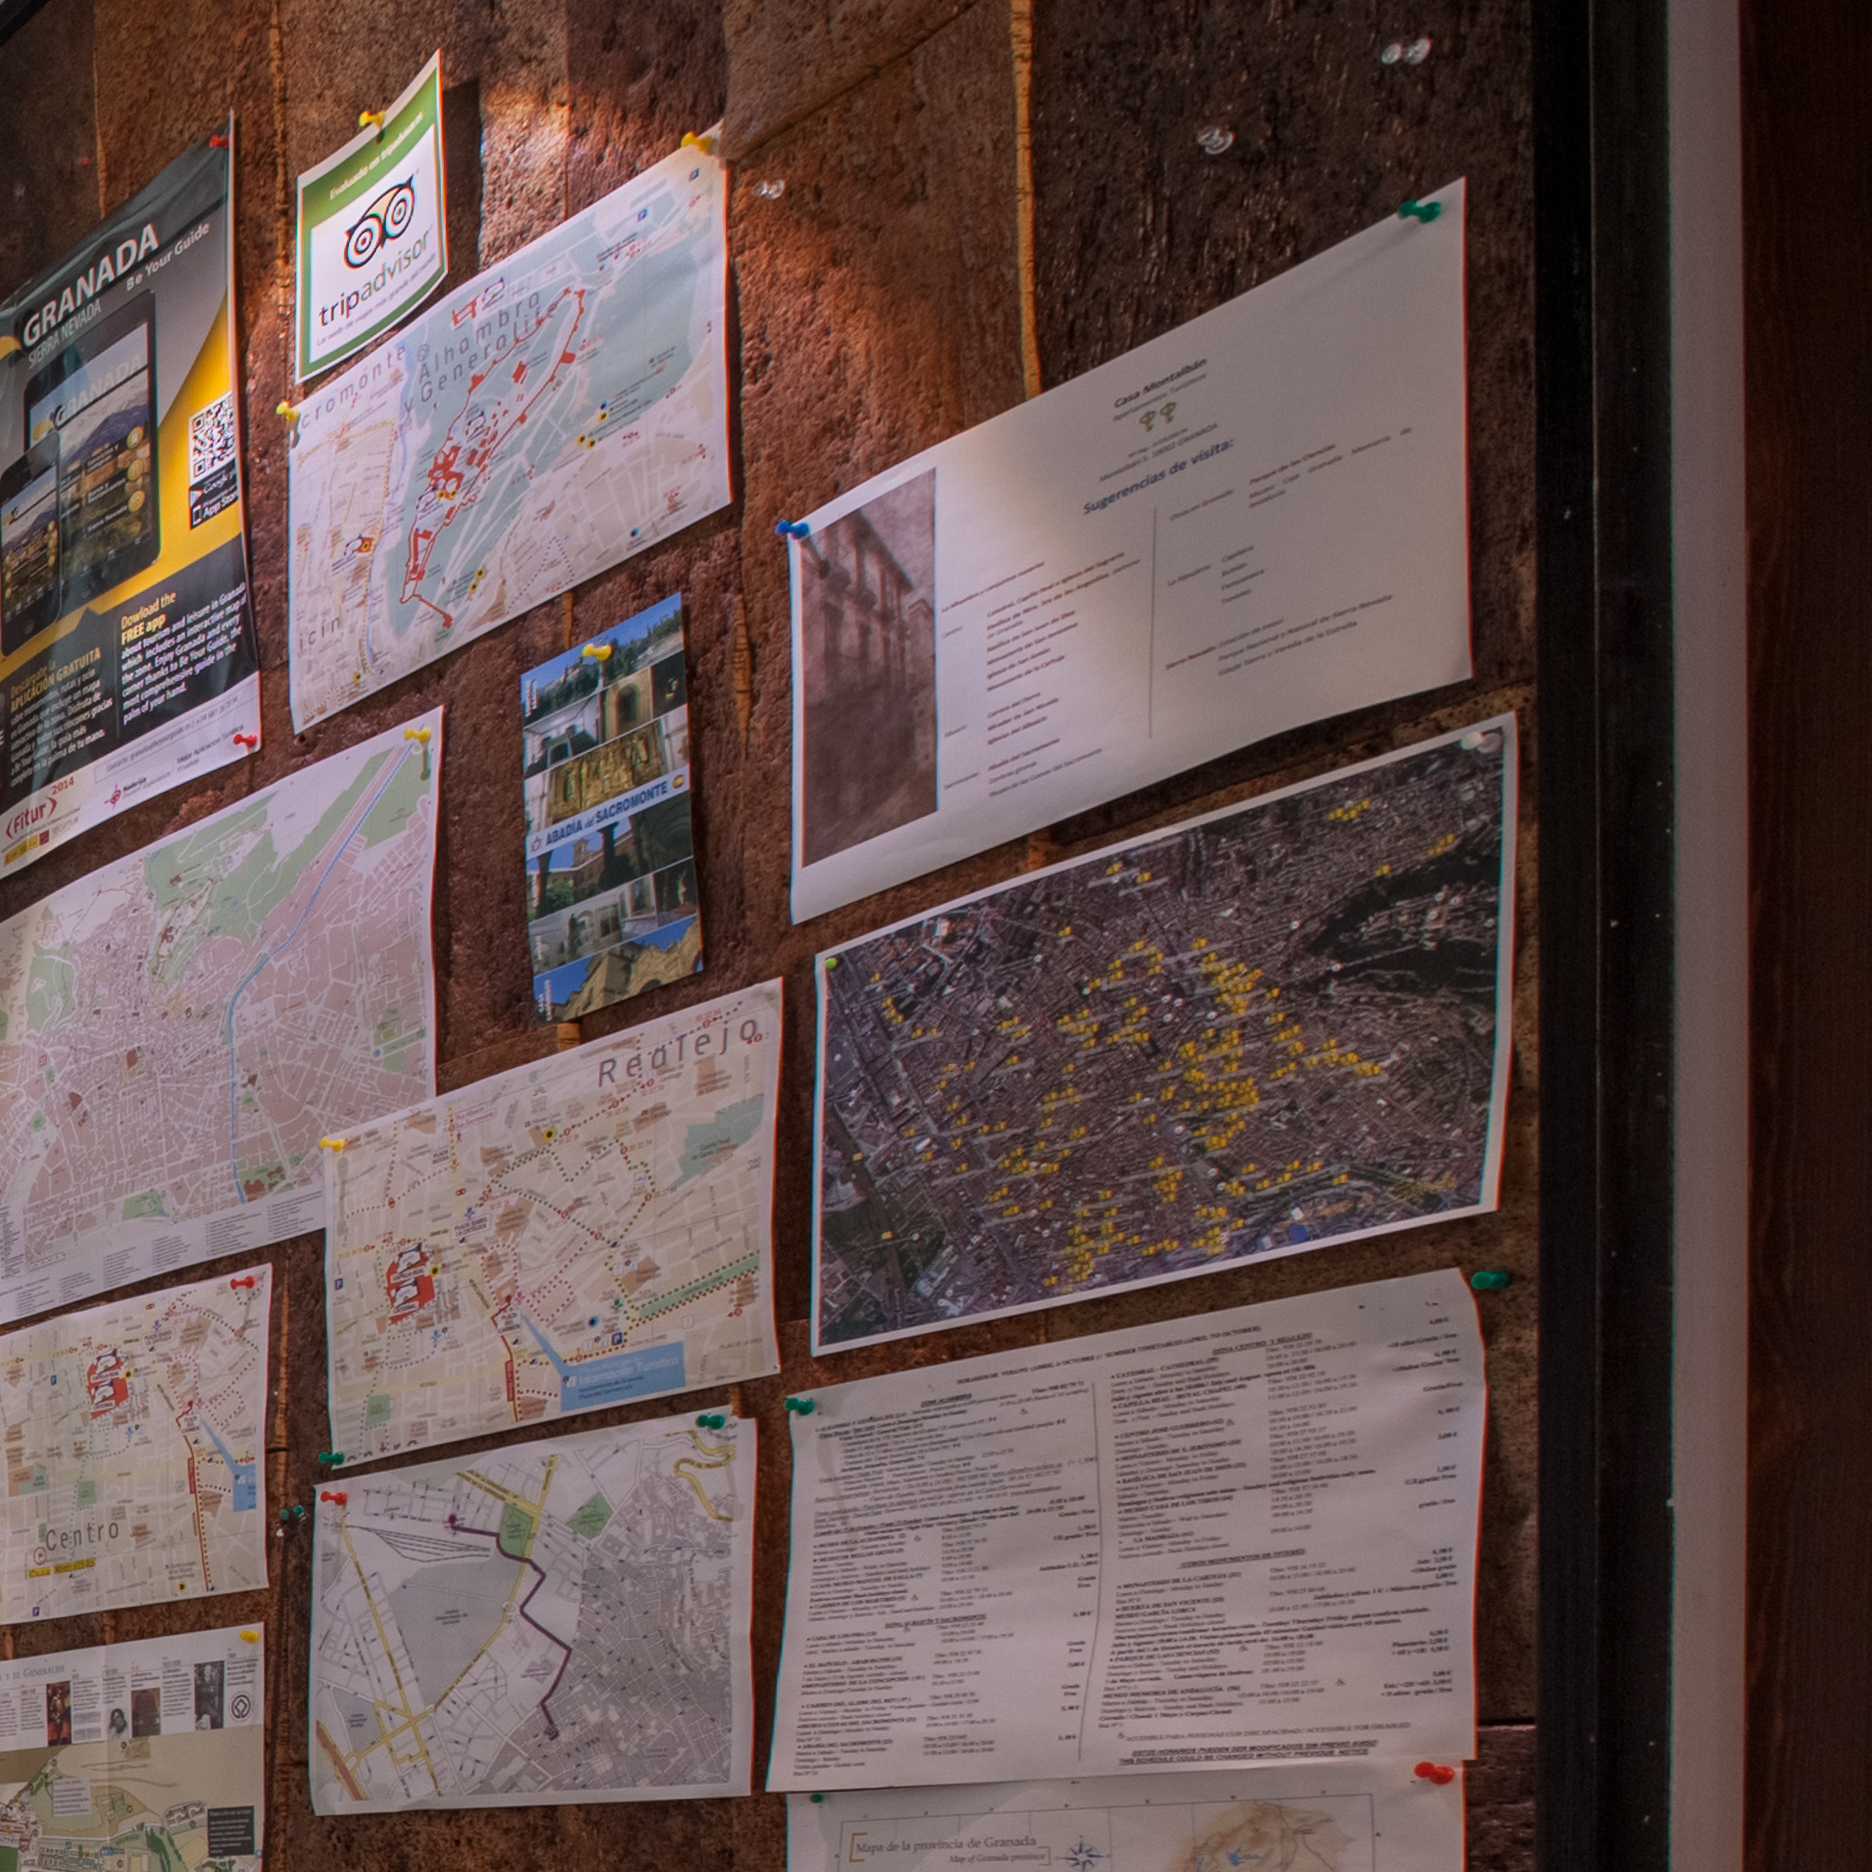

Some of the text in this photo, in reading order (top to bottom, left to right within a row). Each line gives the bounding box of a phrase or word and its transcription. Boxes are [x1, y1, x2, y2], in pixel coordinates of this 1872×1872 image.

[126, 222, 210, 292] Be Your Guide
[24, 223, 160, 348] GRANADA
[319, 230, 429, 328] tripadvisor
[28, 298, 102, 370] SIERRA NEVADA
[328, 324, 342, 342] web
[419, 291, 541, 385] Alhambra
[419, 299, 557, 404] Generalife
[1114, 358, 1208, 408] Casa Montalbán
[1083, 437, 1236, 516] Sugerencias de visita:
[160, 592, 176, 609] the
[171, 615, 186, 633] and
[186, 604, 211, 624] leisure
[121, 613, 167, 646] FREE app
[154, 650, 175, 668] Enjoy
[175, 632, 206, 656] Granada
[206, 622, 222, 640] and
[221, 612, 242, 632] every
[186, 609, 225, 638] interactive
[56, 647, 102, 682] GRATUITA
[140, 666, 194, 701] comprehensive
[51, 776, 75, 796] 2014
[596, 780, 669, 824] SACROMONTE
[13, 801, 47, 830] Fitur
[597, 1018, 758, 1088] Realejo
[45, 1521, 120, 1552] Centro
[856, 1834, 1037, 1856] Mapa de la provincia de Granada
